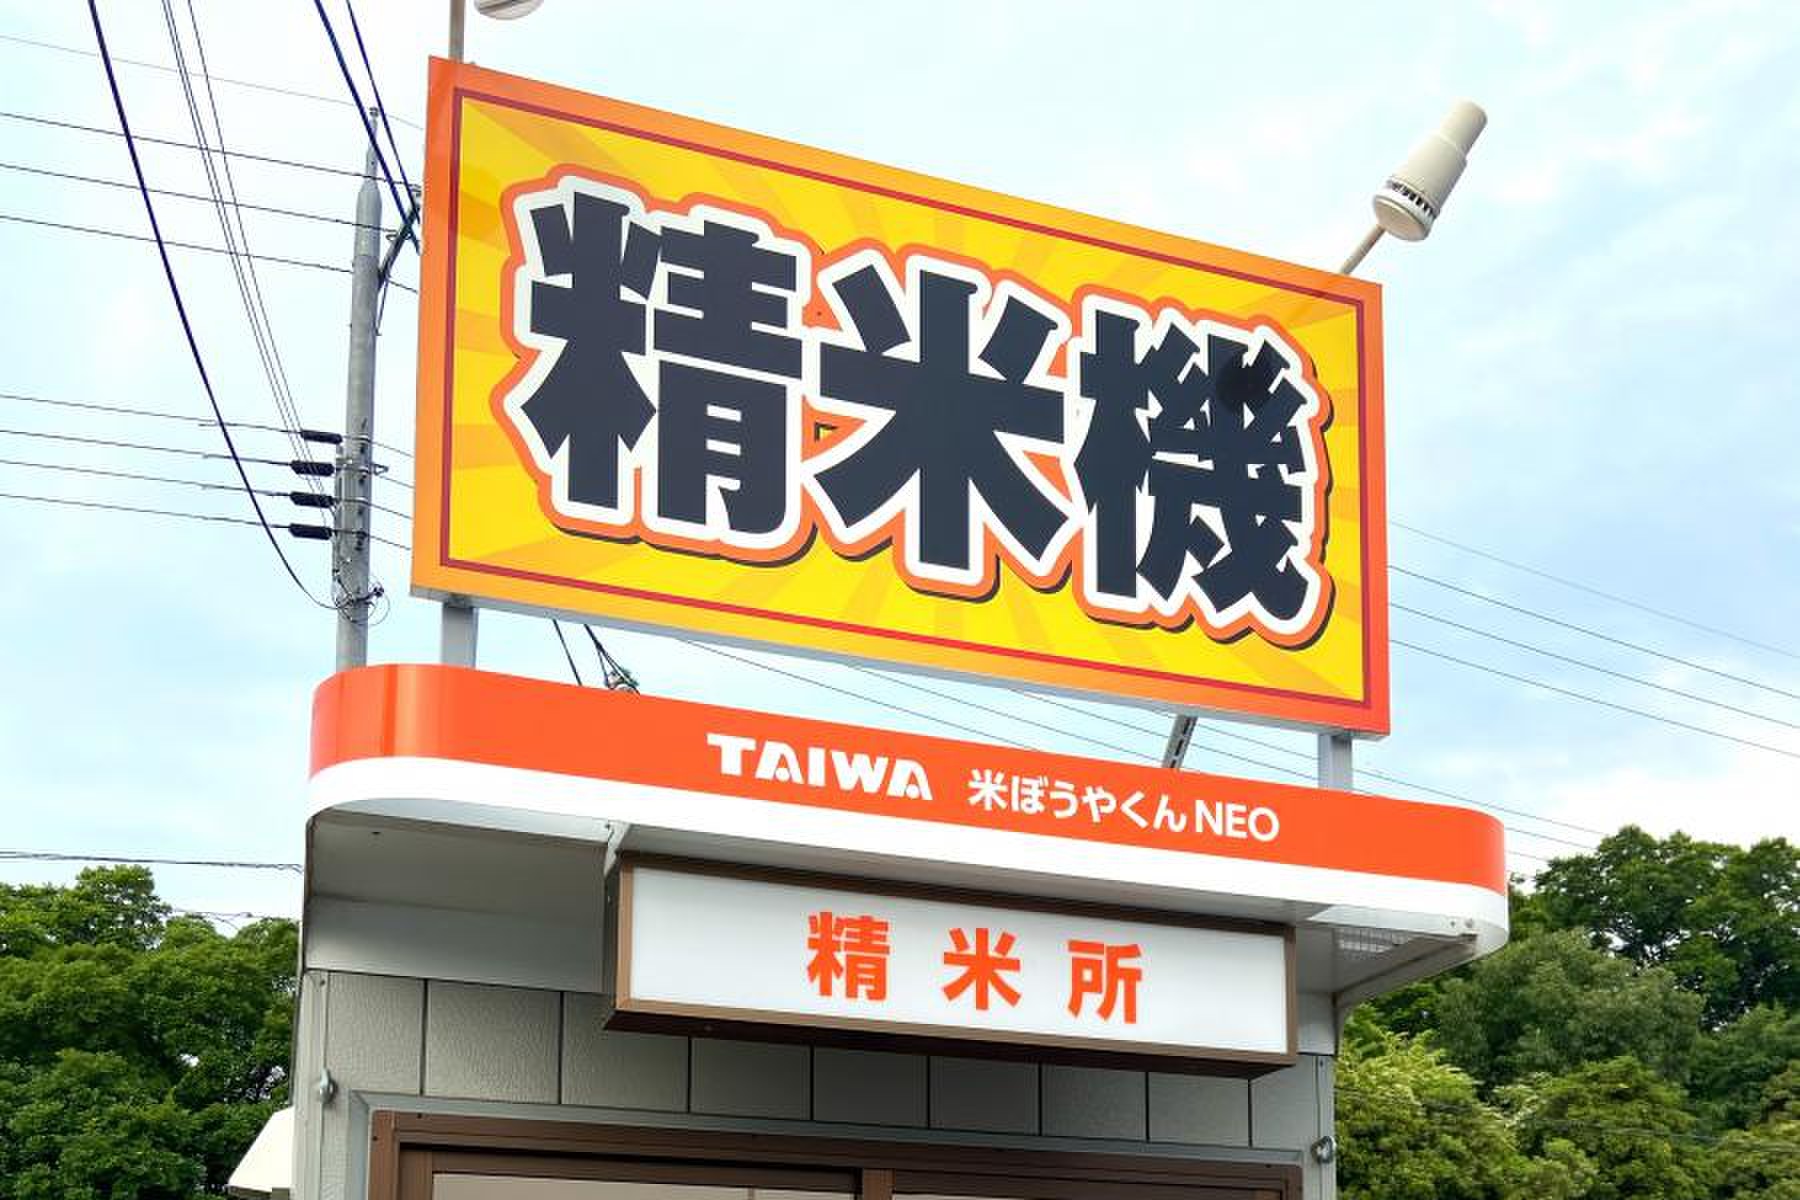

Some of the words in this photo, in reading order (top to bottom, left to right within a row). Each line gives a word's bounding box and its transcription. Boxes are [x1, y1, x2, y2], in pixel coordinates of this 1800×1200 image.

[522, 191, 1308, 622] 精米機
[707, 732, 933, 801] TAIWA
[806, 911, 1142, 1024] 精米所
